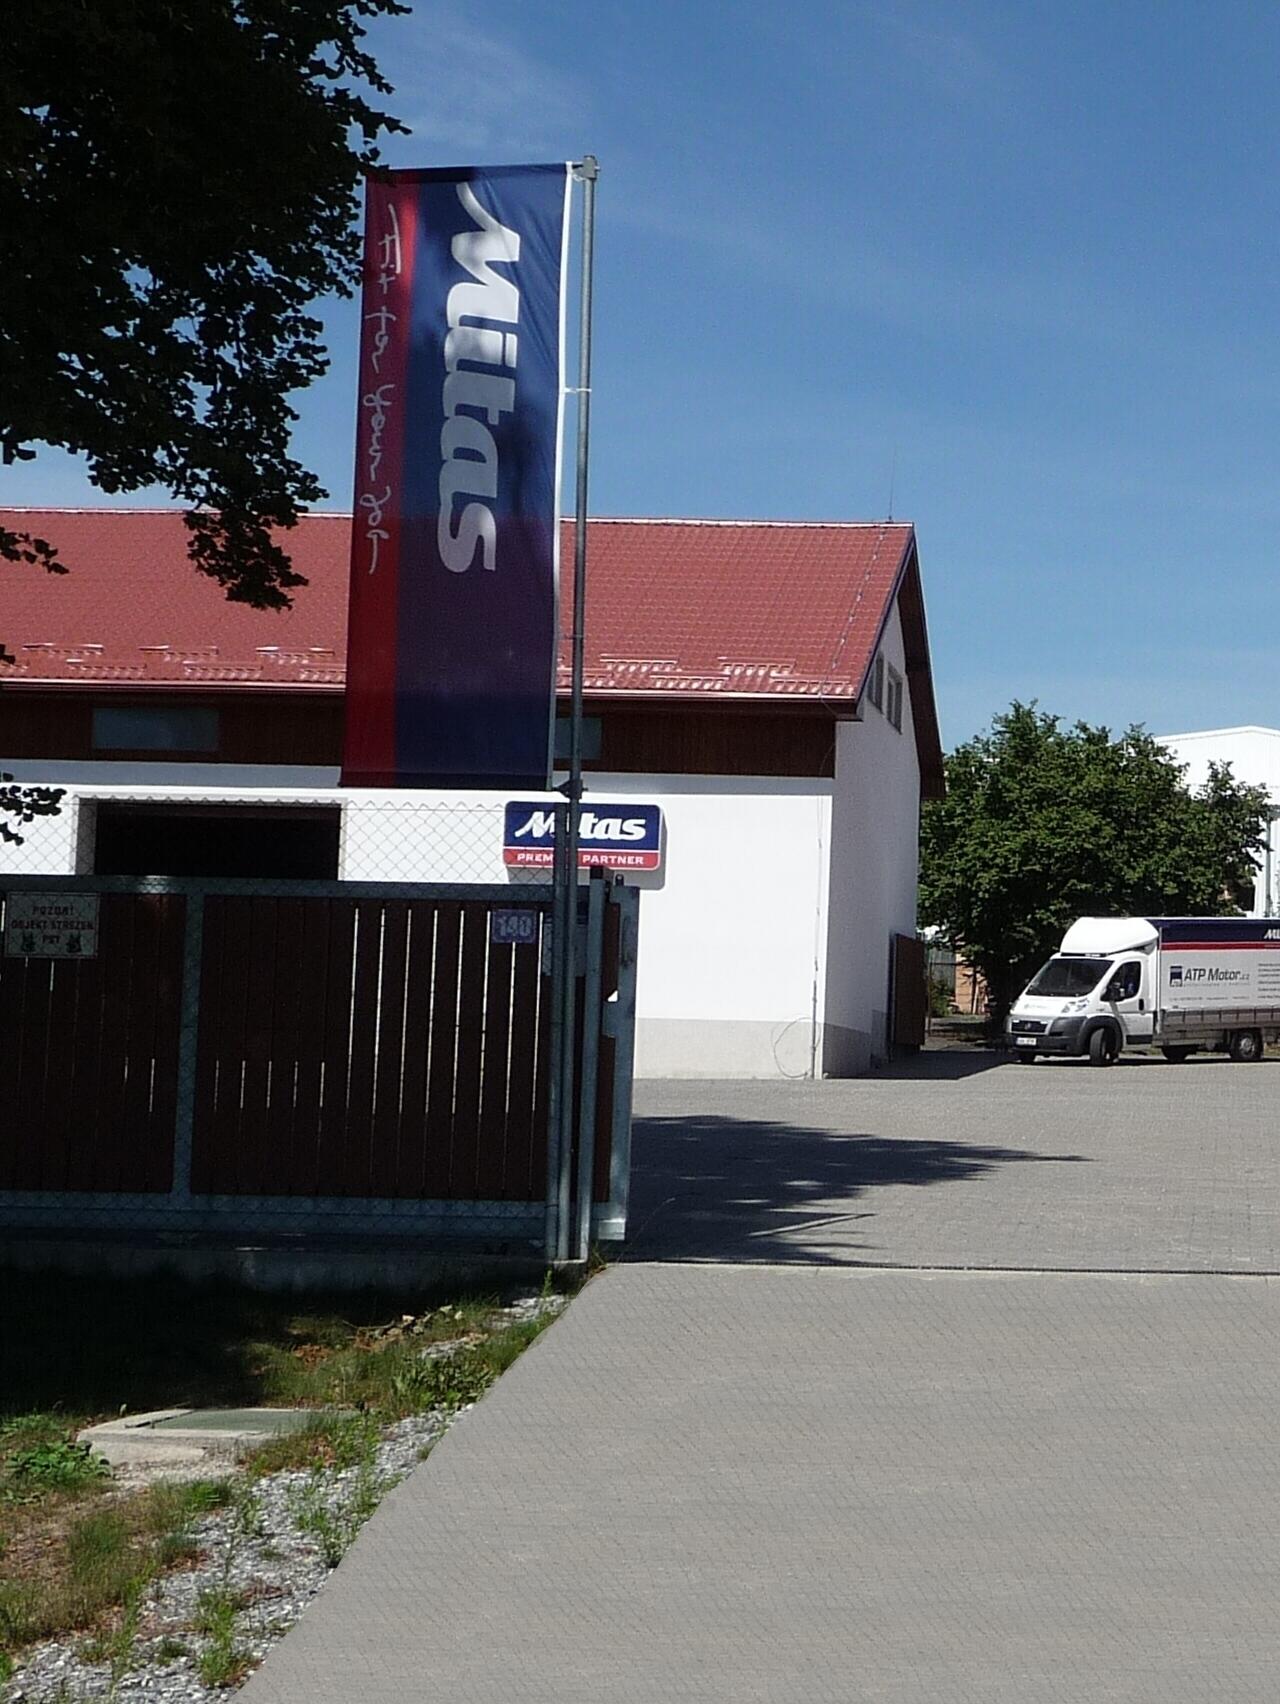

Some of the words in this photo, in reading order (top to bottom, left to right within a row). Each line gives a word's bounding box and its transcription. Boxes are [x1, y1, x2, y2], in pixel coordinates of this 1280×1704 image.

[437, 182, 521, 574] Mitas
[514, 811, 646, 841] Mtas
[582, 854, 644, 865] PARTNER
[1184, 968, 1206, 981] ATP
